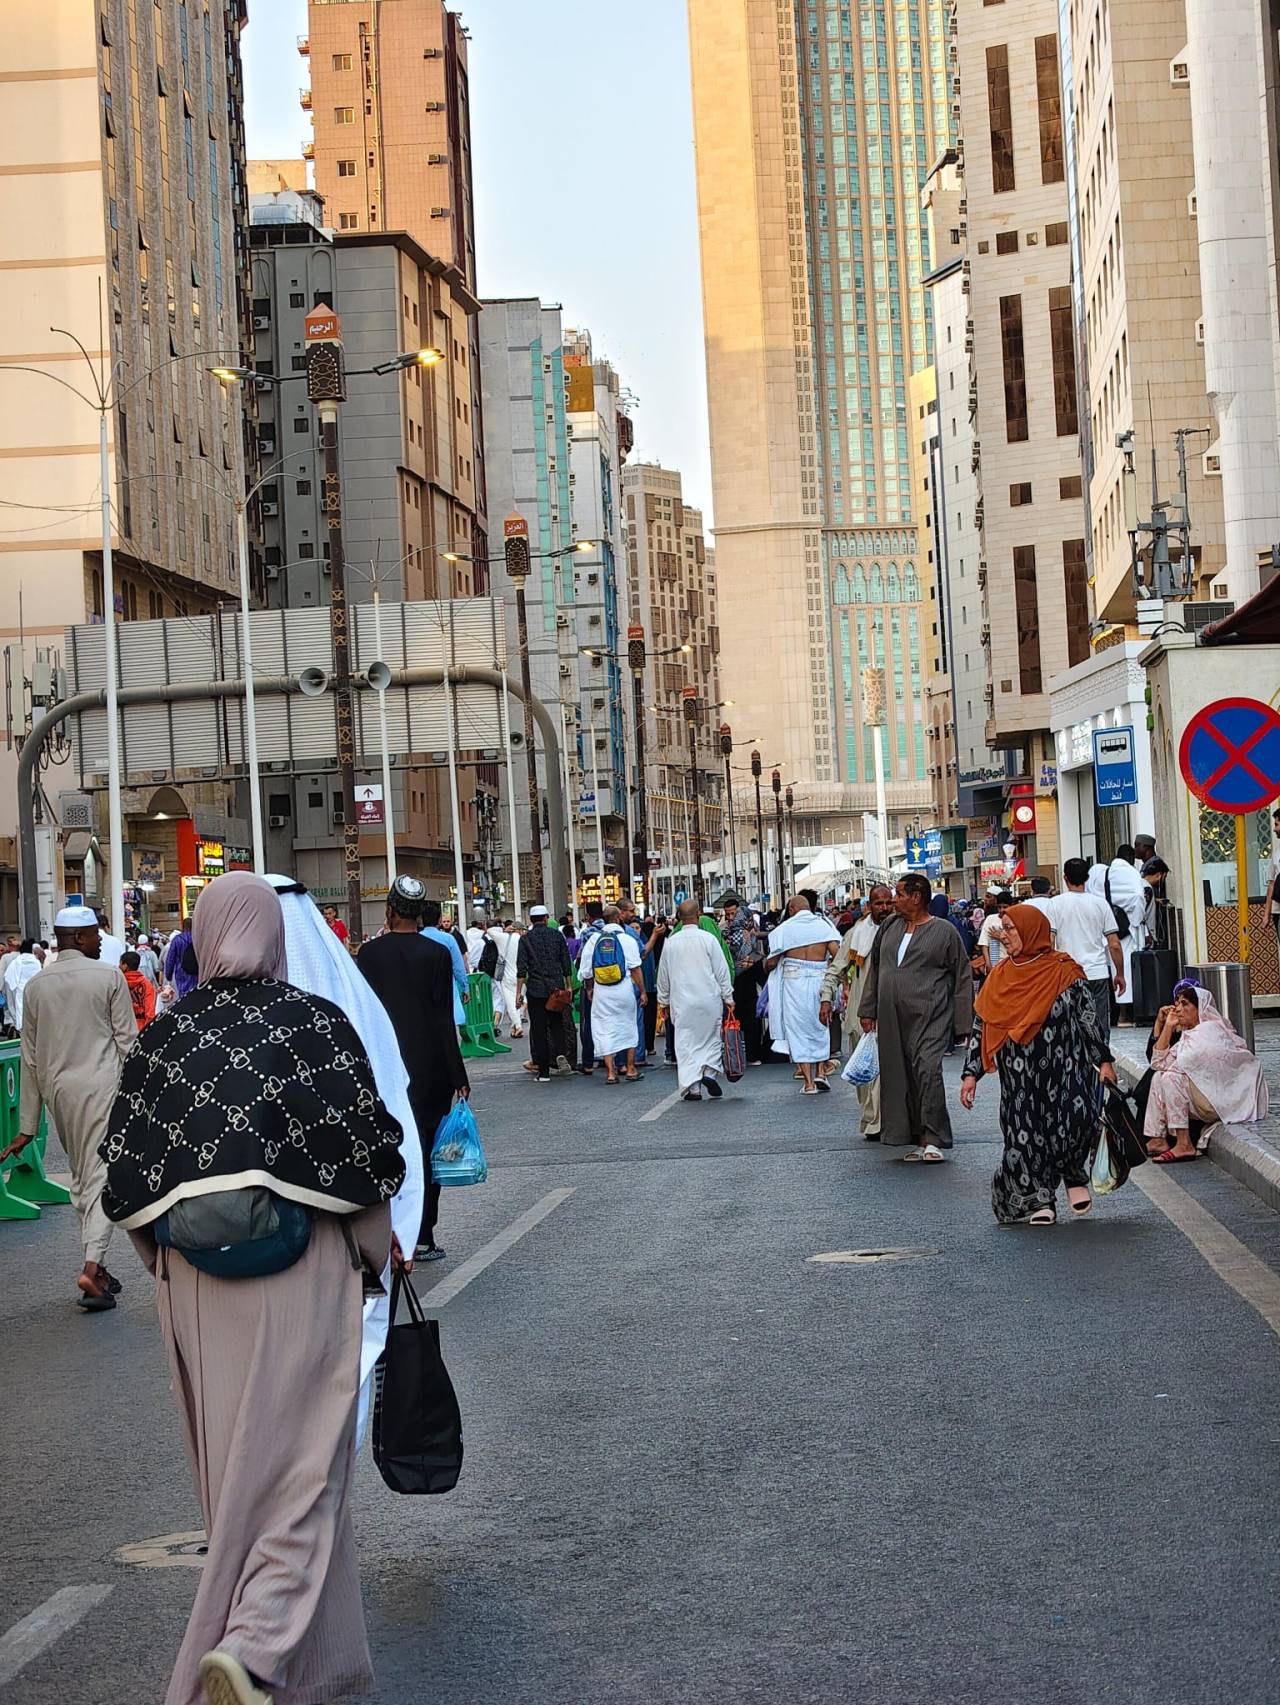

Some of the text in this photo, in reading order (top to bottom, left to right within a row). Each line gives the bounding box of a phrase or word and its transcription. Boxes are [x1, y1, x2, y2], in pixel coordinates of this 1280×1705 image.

[309, 320, 333, 335] الرحيم
[507, 522, 524, 532] العزيز
[1100, 778, 1134, 790] مسار للحافلات
[1111, 790, 1122, 801] فقط
